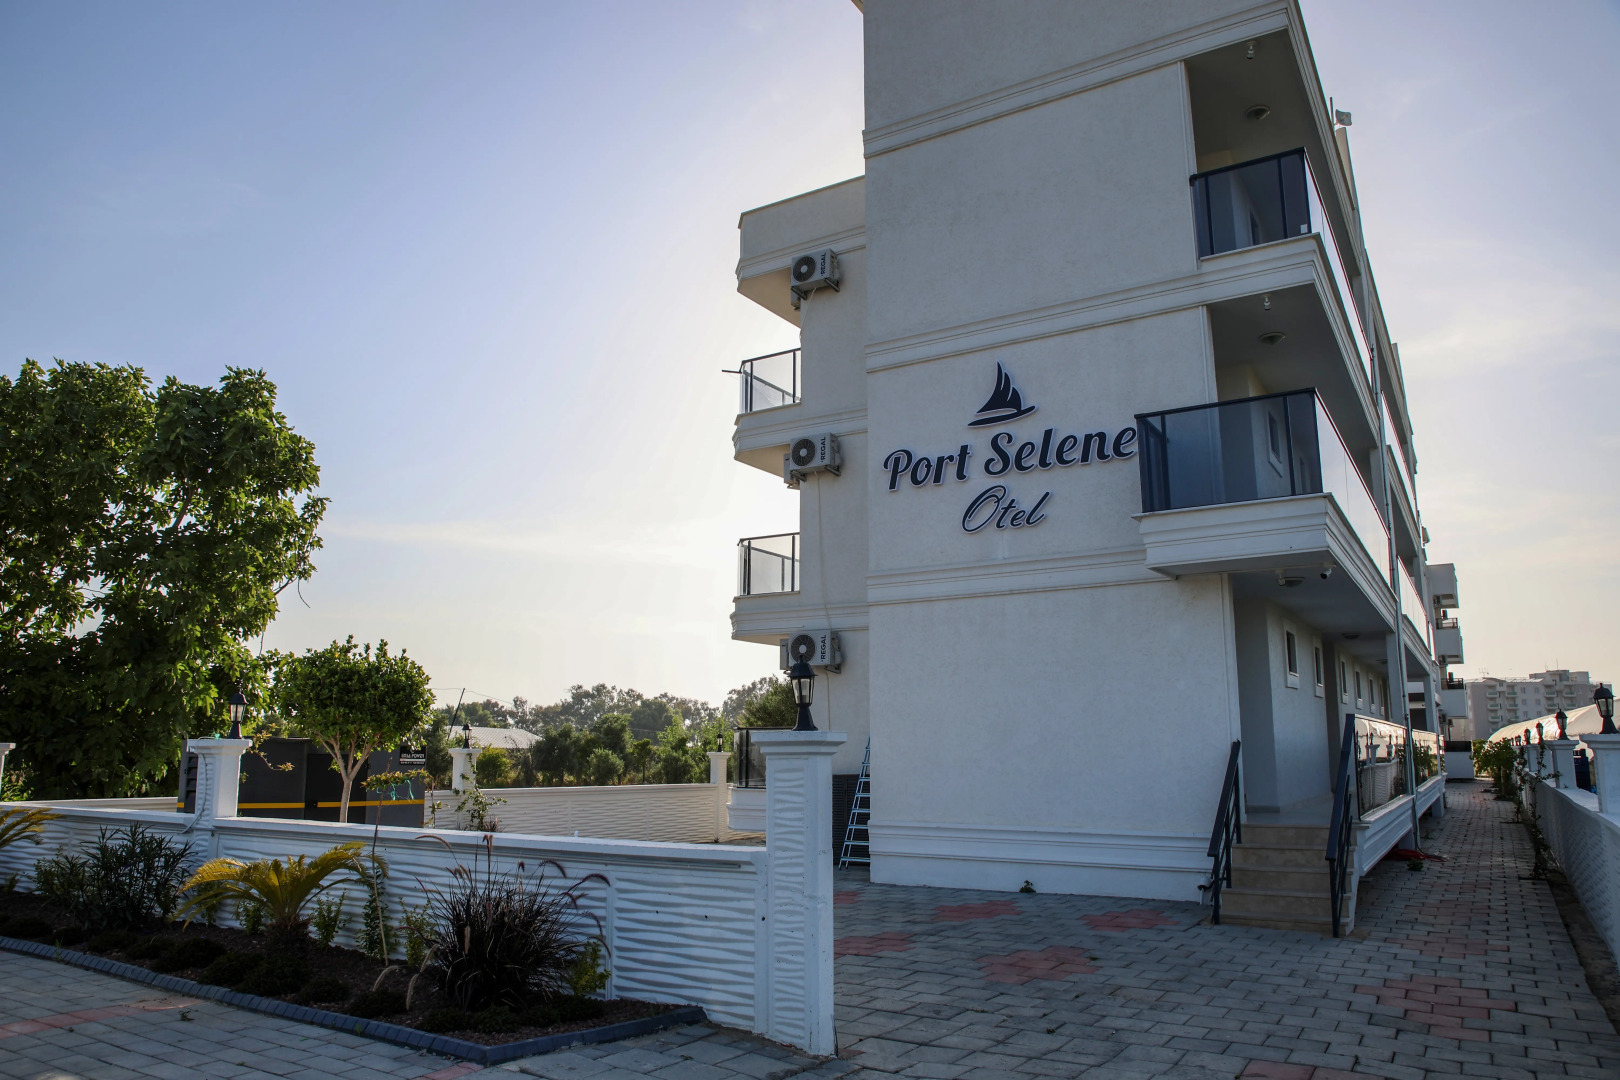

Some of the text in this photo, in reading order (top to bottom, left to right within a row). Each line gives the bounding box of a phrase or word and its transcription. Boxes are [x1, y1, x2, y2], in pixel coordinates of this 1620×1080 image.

[883, 426, 1138, 491] Port Selene
[961, 485, 1051, 533] Otel
